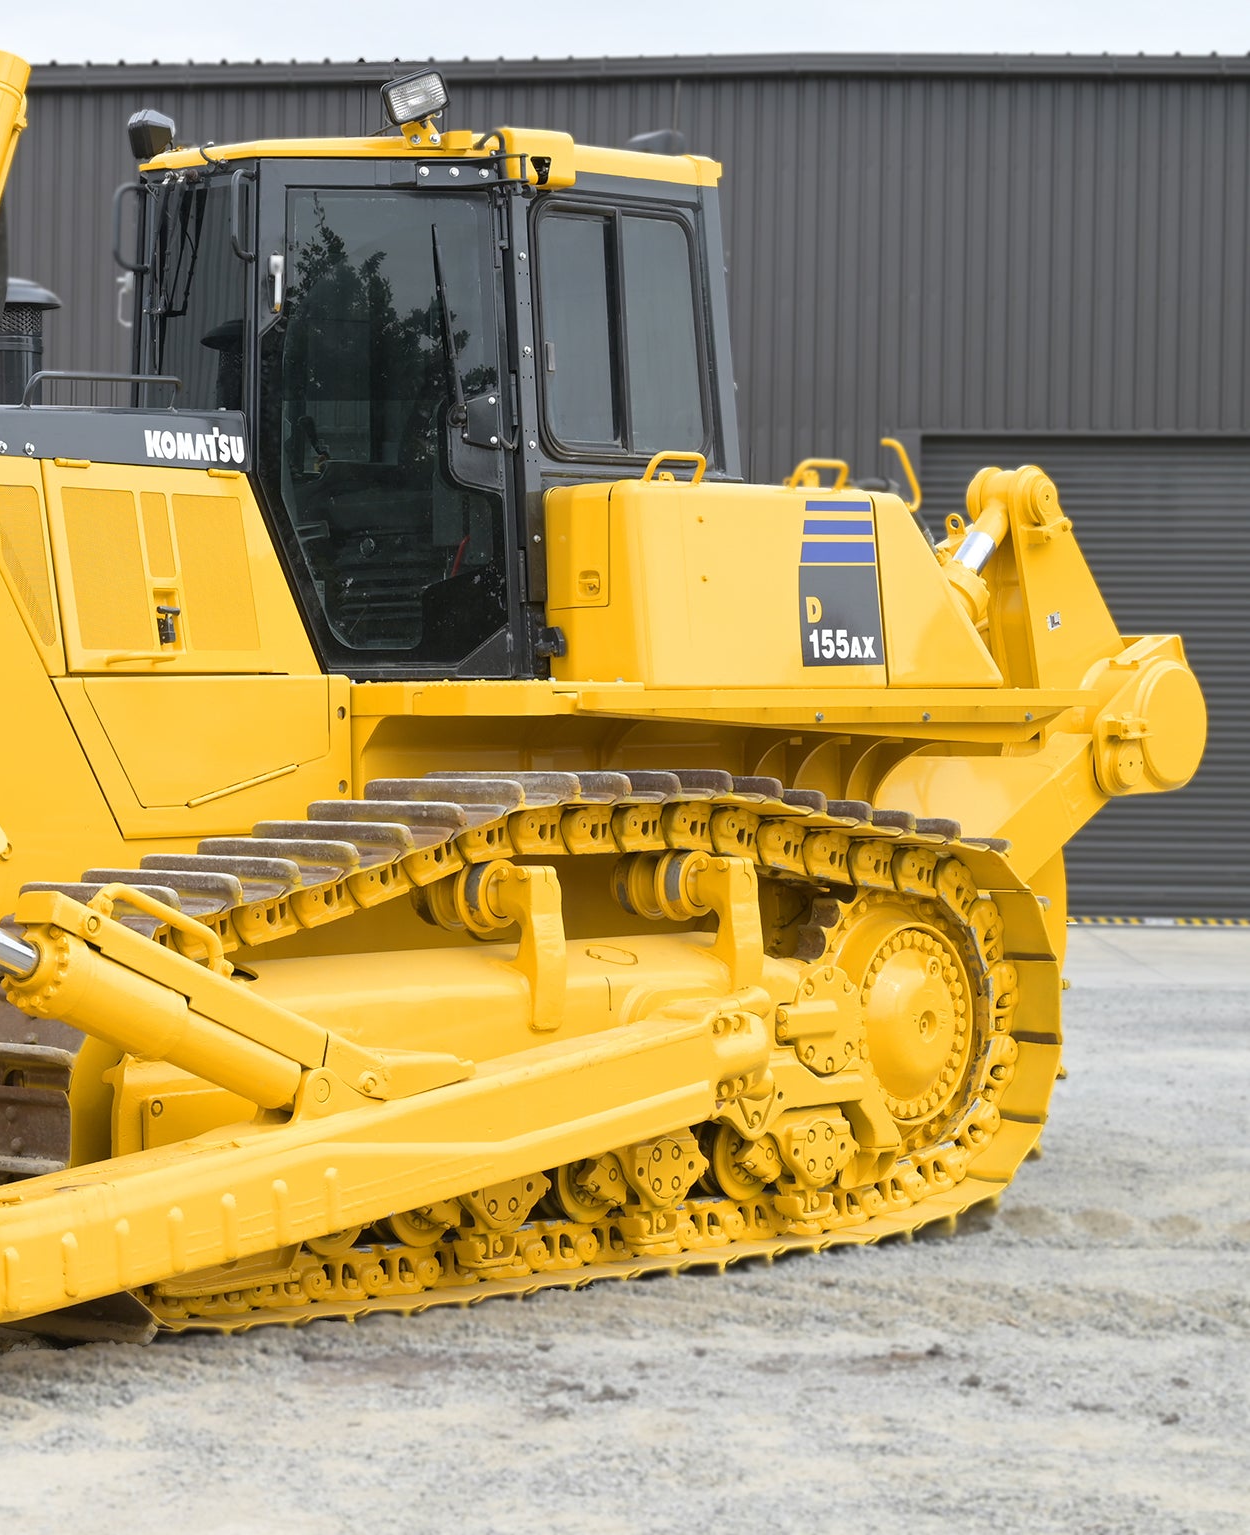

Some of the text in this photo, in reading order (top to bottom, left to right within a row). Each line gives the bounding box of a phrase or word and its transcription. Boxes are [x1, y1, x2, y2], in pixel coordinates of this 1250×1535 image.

[143, 426, 245, 464] KOMATSU
[805, 596, 823, 624] D
[808, 628, 877, 659] 155AX
